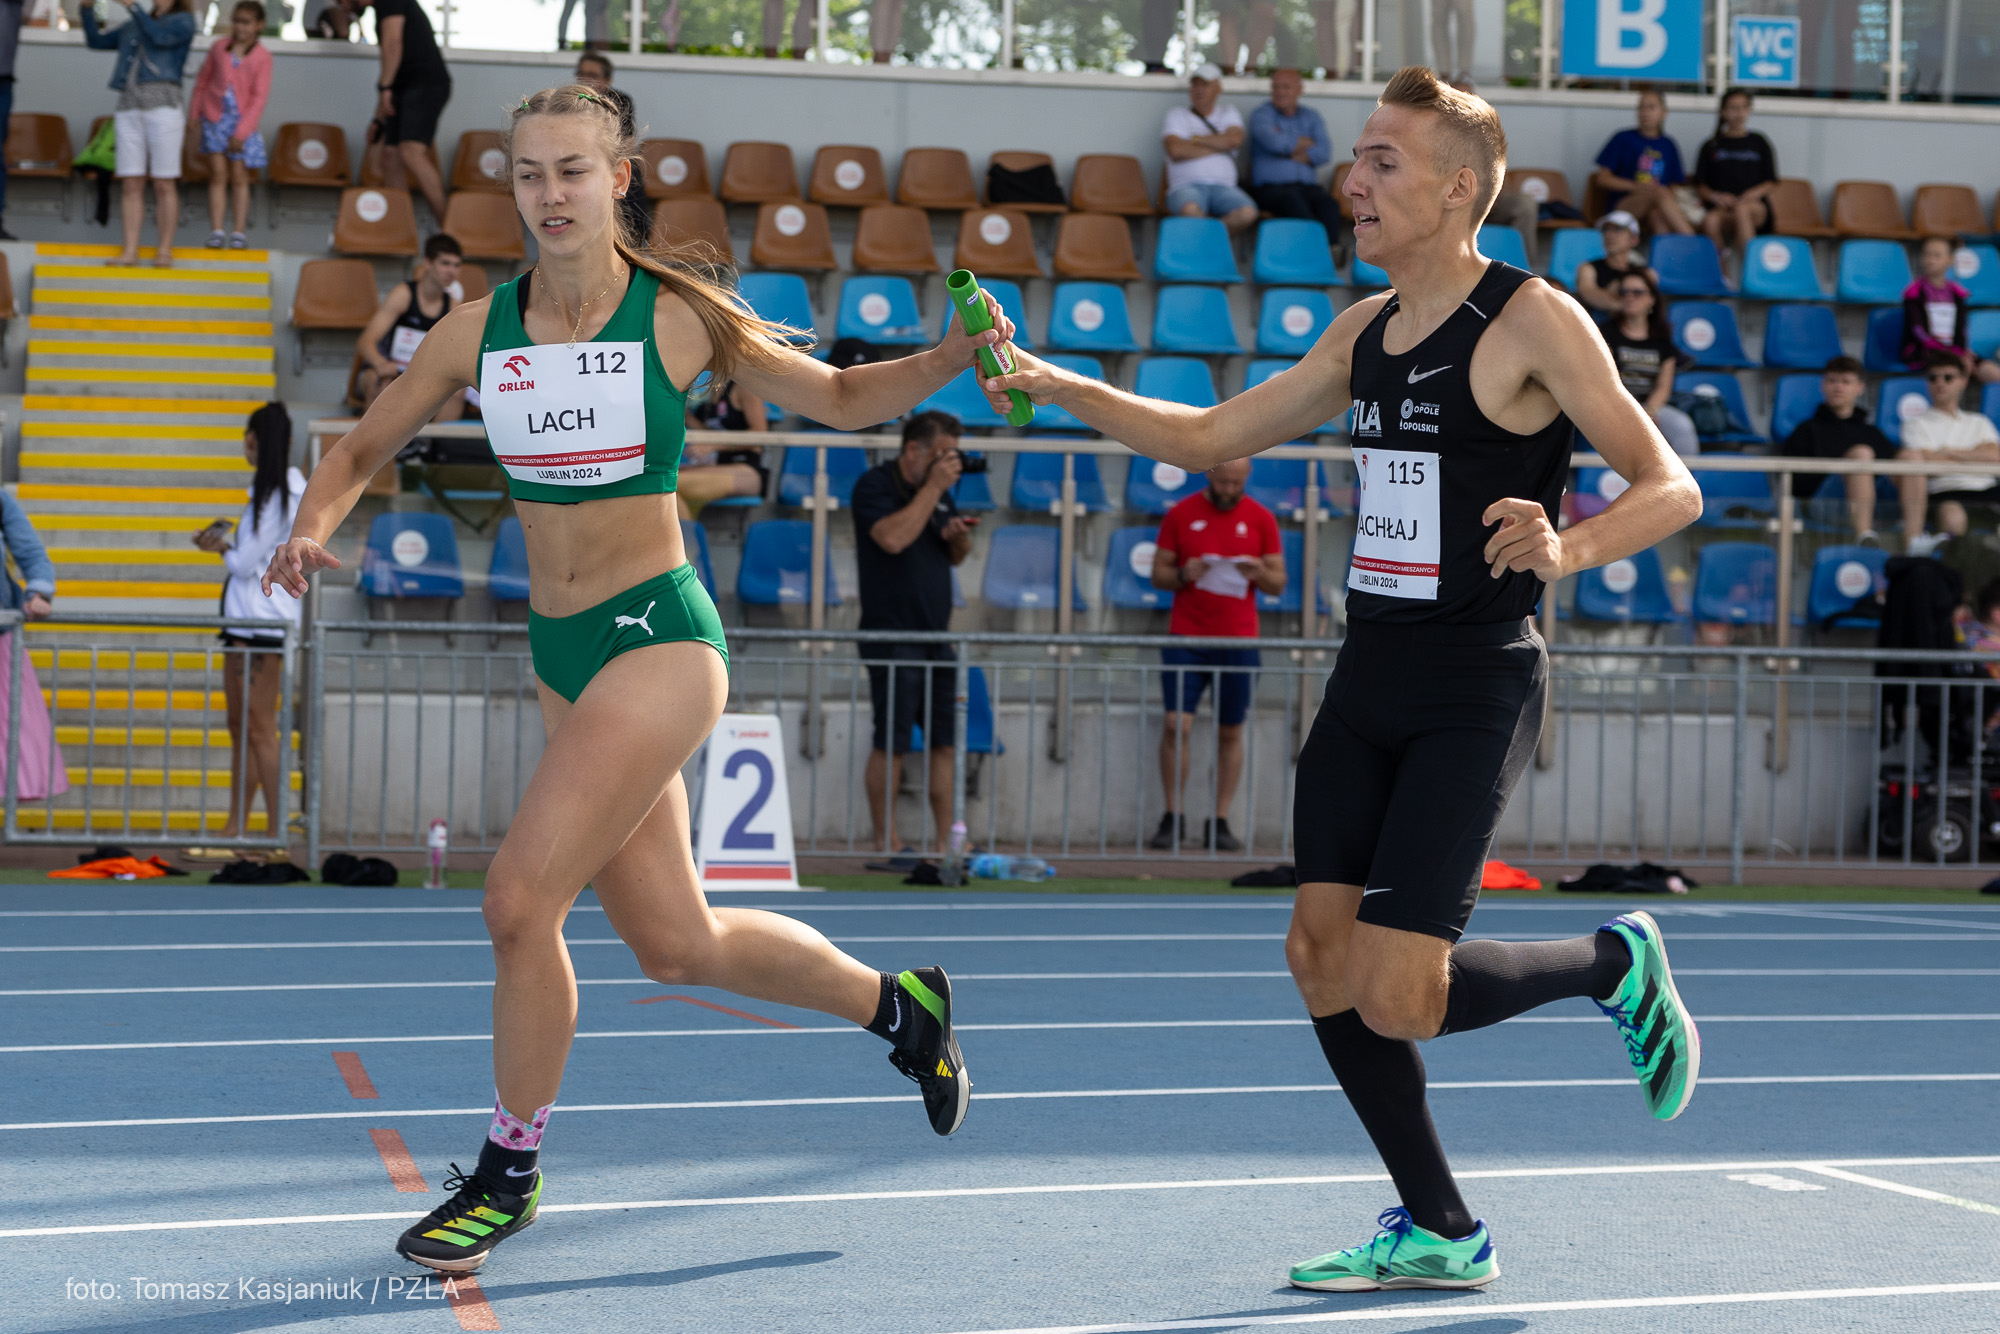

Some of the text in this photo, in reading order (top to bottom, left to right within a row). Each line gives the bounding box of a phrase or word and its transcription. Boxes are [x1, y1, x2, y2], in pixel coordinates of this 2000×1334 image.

[1594, 0, 1669, 69] B
[1738, 25, 1794, 59] WC
[576, 351, 627, 375] 112
[498, 380, 535, 393] ORLEN
[527, 407, 596, 435] LACH
[1413, 405, 1440, 416] OPOLE
[544, 456, 562, 464] POLSKI
[568, 453, 605, 463] SZTAFETACH
[604, 448, 642, 460] MIESZANYCH
[536, 467, 602, 480] LUBLIN 2024
[1387, 460, 1425, 486] 115
[1357, 514, 1418, 541] ACHŁAJ
[1358, 573, 1398, 589] LUBLIN 2024
[1401, 566, 1436, 574] MIESZANYCH
[721, 748, 775, 850] 2
